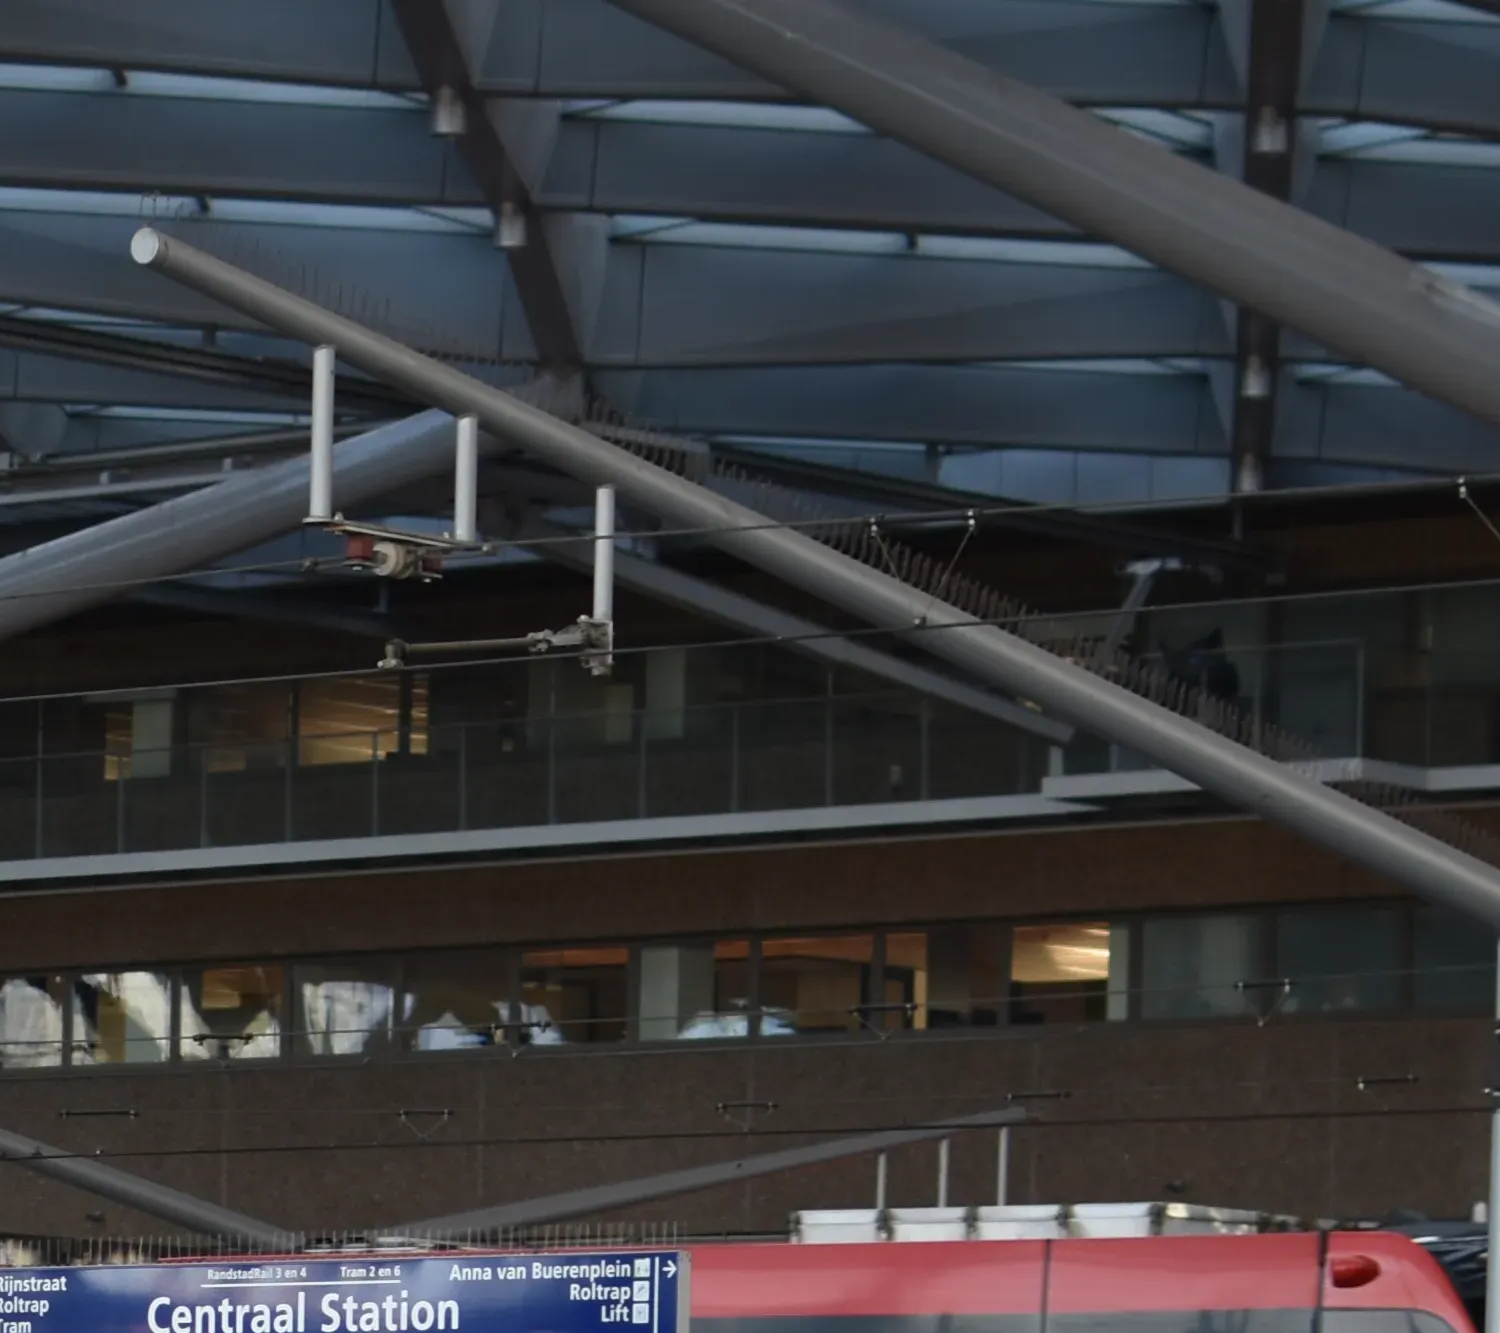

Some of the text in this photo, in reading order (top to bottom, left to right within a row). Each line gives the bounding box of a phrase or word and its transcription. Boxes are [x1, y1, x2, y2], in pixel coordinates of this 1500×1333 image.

[208, 1267, 307, 1280] RandstadRail 3 en 4
[340, 1265, 401, 1278] Tram 2 en 6
[449, 1260, 631, 1283] Anna van Buerenplein
[569, 1283, 631, 1305] Roltrap
[320, 1289, 460, 1333] Station
[600, 1305, 630, 1323] Lift
